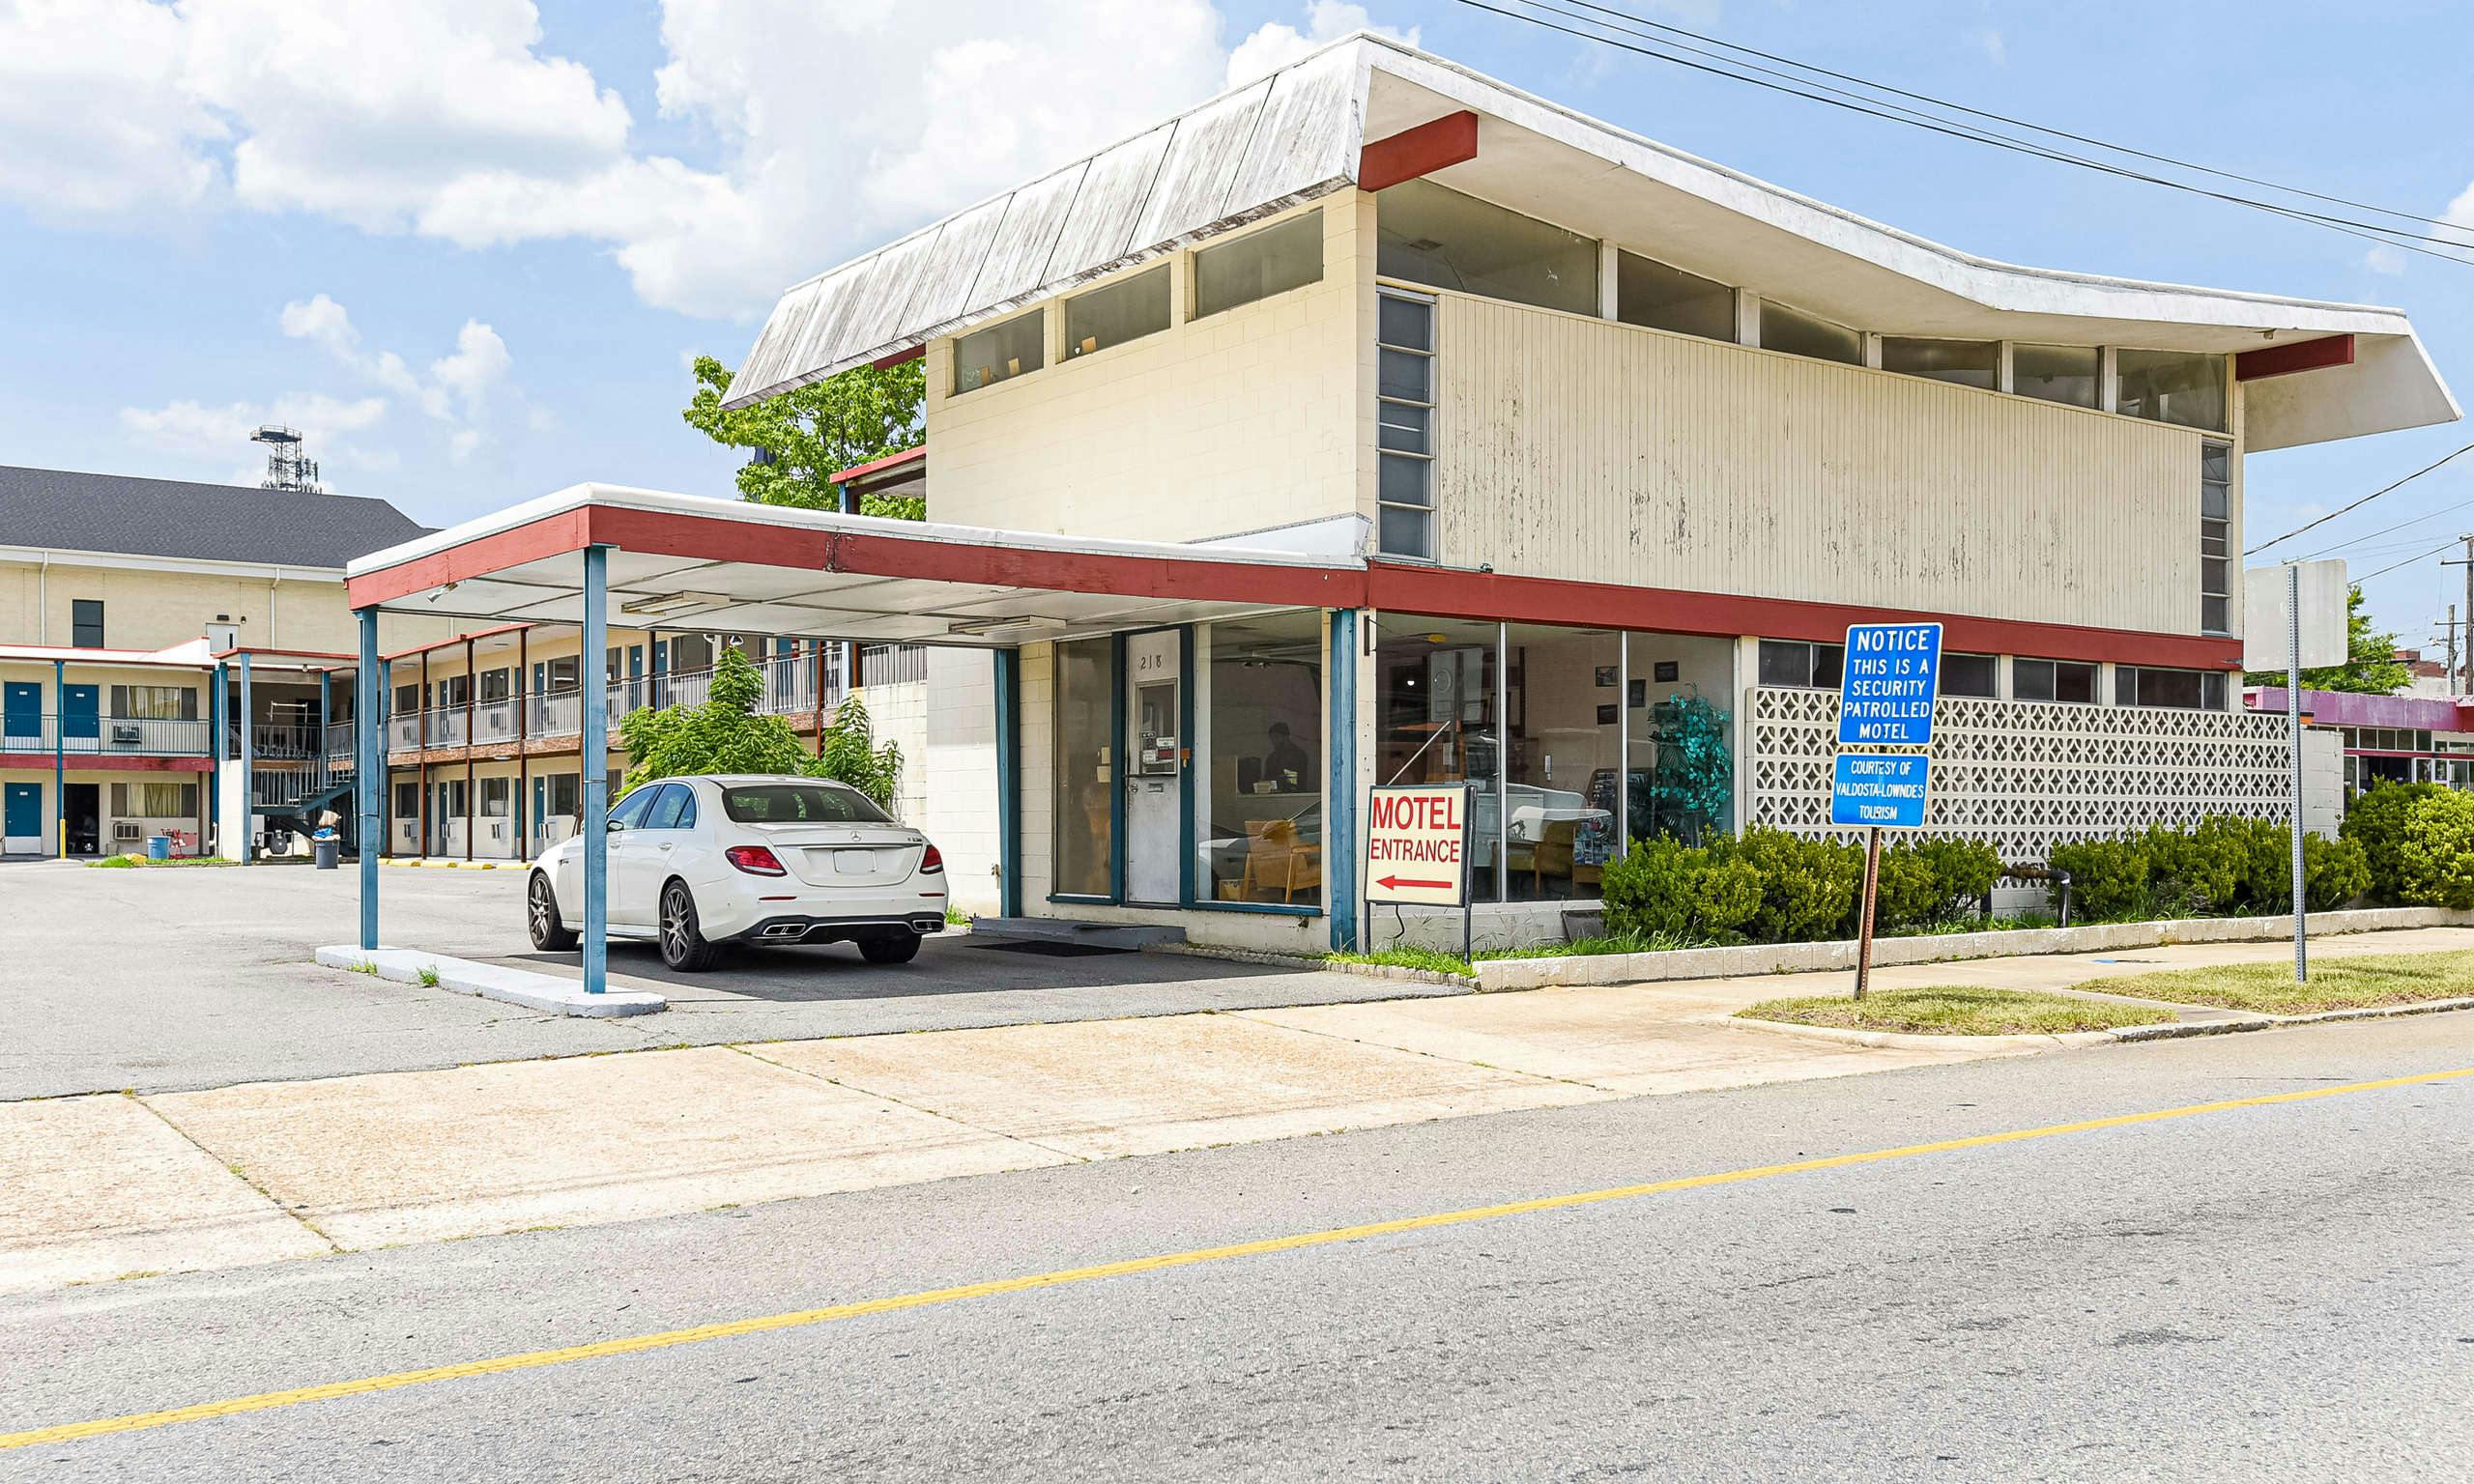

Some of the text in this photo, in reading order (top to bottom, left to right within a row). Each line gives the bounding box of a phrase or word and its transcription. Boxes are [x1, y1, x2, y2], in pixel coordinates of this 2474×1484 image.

[1856, 629, 1930, 651] NOTICE
[1140, 654, 1162, 671] 218
[1854, 658, 1929, 674] THIS IS A
[1852, 680, 1926, 697] SECURITY
[1843, 701, 1930, 718] PATROLLED
[1858, 723, 1909, 739] MOTEL
[1851, 760, 1913, 775] COURTESY OF
[1836, 782, 1924, 799] VALDOSTA-LOWNDES
[1372, 795, 1461, 830] MOTEL
[1859, 805, 1898, 820] TOURISM
[1370, 838, 1460, 863] ENTRANCE
